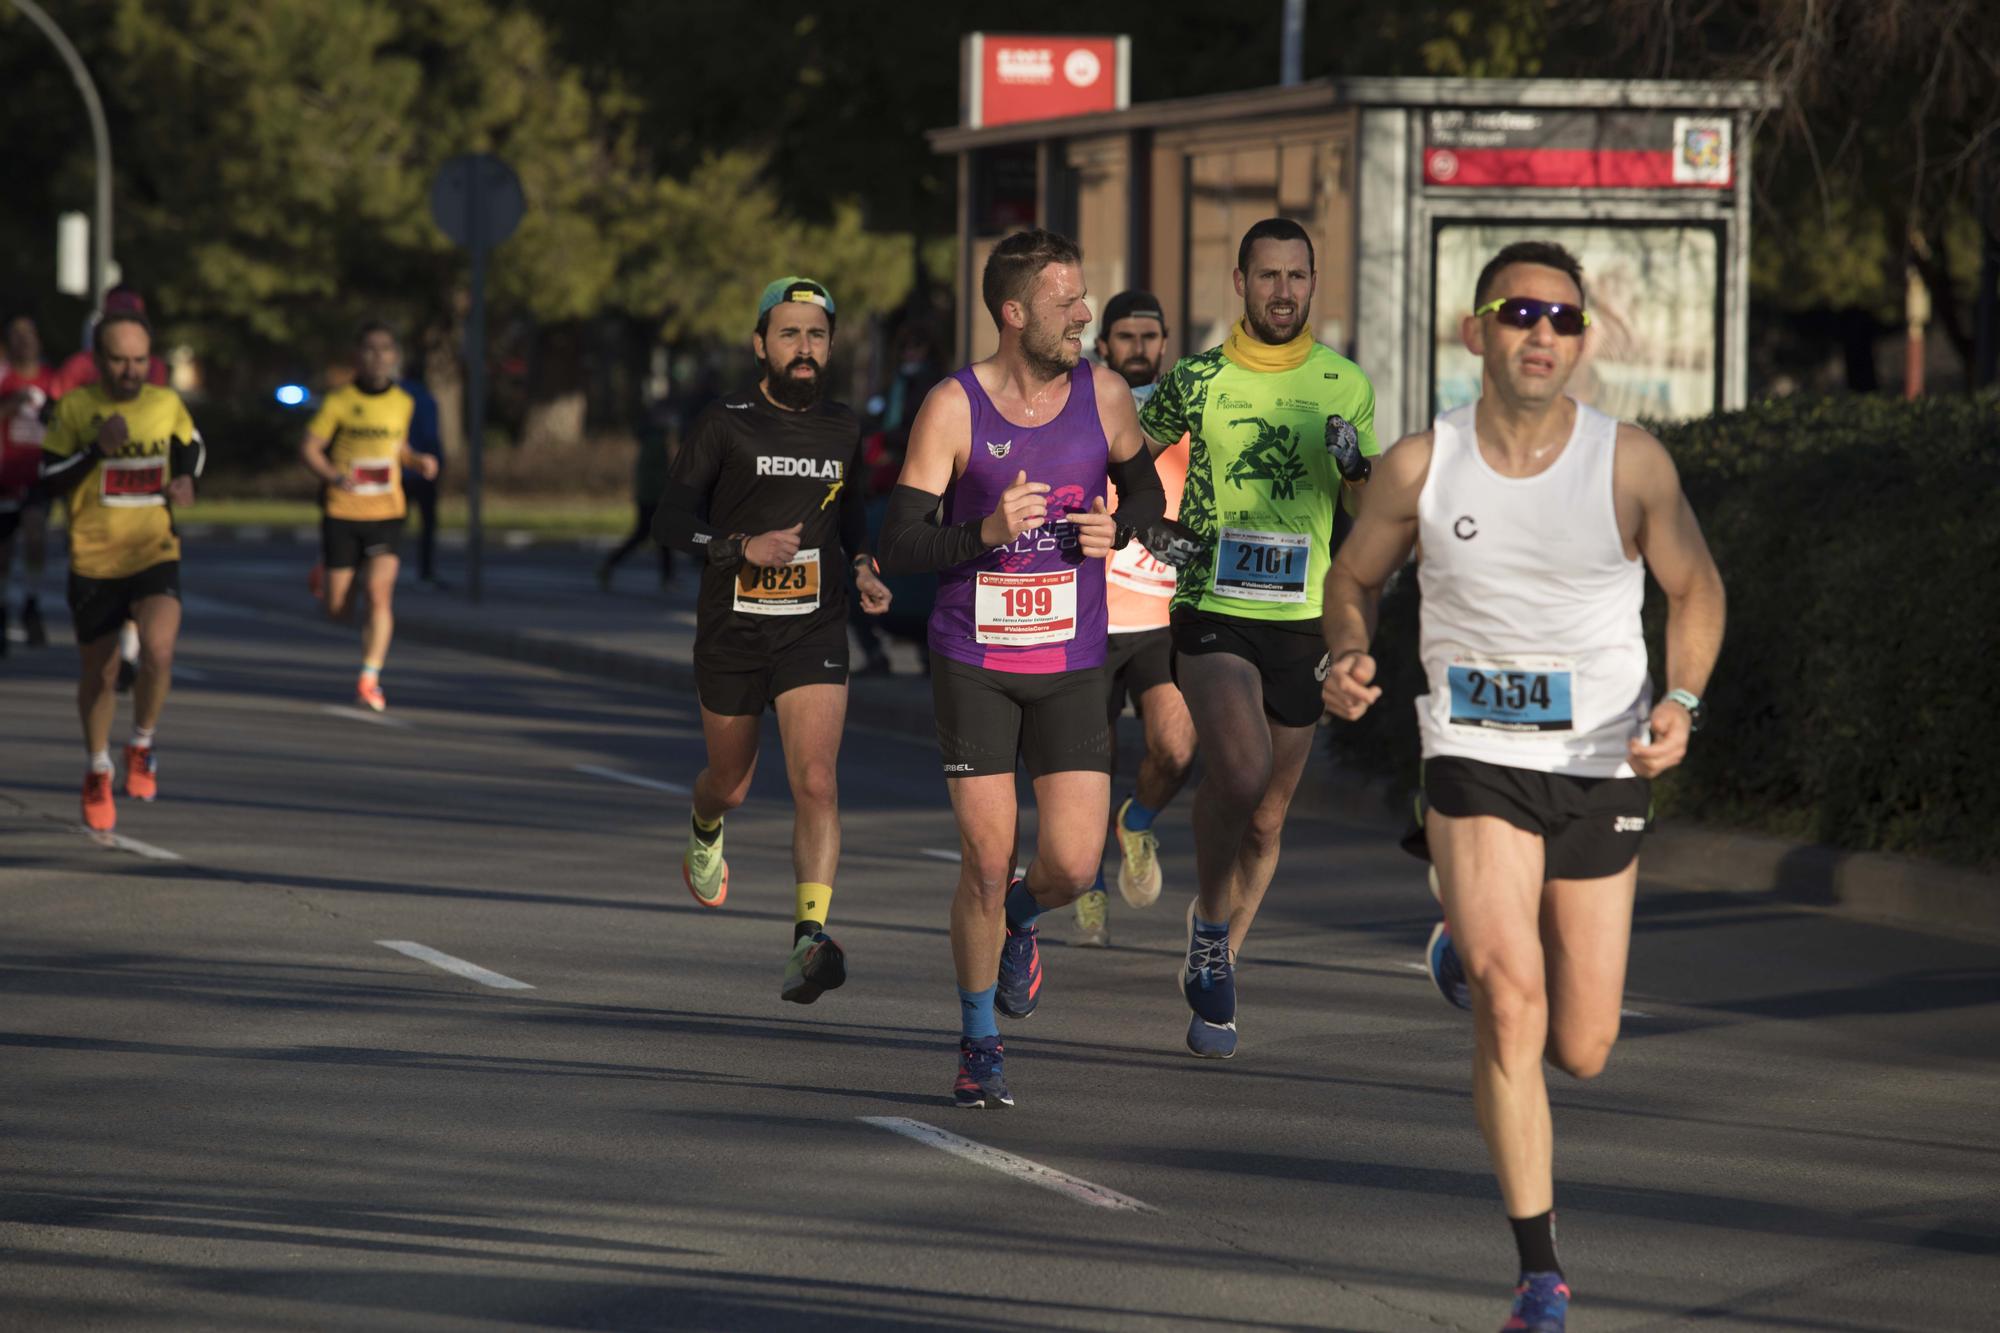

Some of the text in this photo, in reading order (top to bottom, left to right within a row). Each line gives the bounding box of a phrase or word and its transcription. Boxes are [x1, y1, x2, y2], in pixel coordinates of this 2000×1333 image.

[756, 456, 842, 479] REDOLAT
[1453, 516, 1478, 541] C
[1236, 544, 1293, 576] 2101
[751, 565, 806, 590] 7823
[1001, 587, 1052, 617] 199
[1467, 670, 1551, 710] 2154
